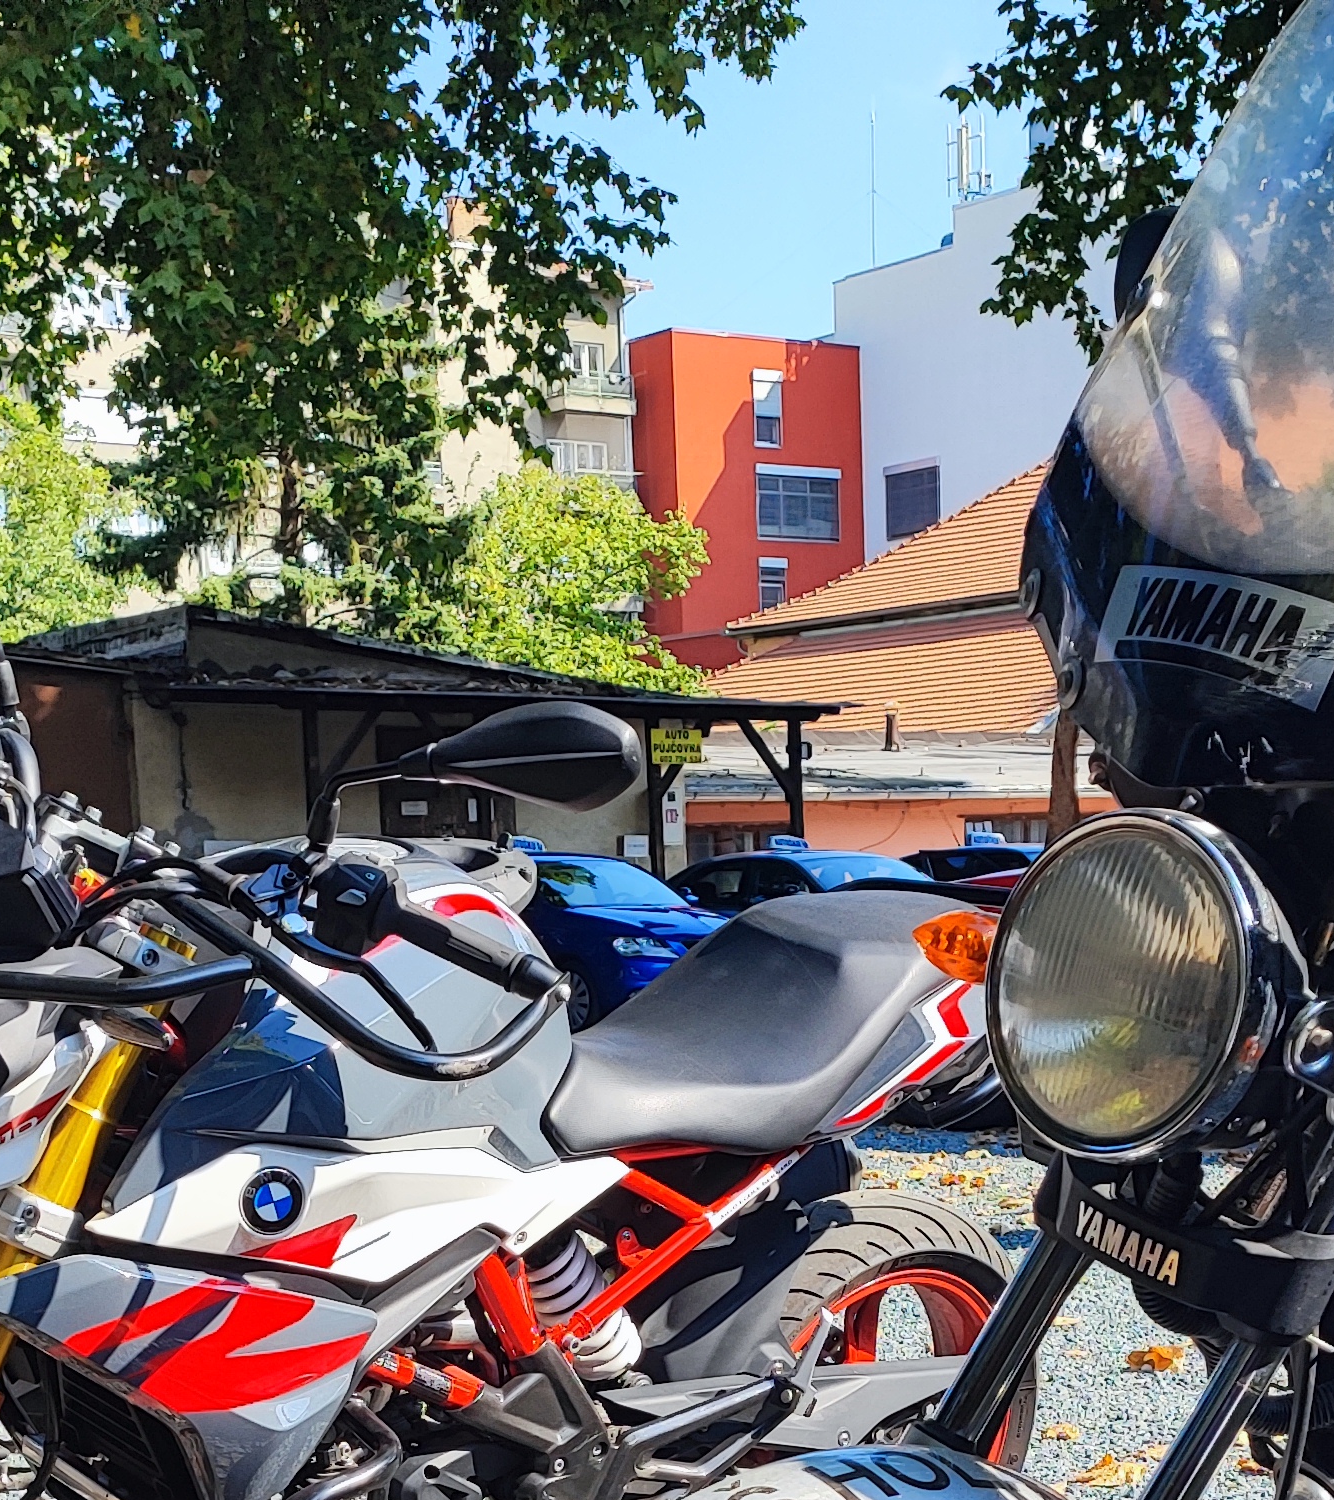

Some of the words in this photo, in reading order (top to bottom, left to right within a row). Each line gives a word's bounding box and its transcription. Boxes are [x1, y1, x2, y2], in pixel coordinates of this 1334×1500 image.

[1124, 576, 1307, 667] YAMAHA
[664, 729, 690, 740] AUTO
[245, 1170, 294, 1199] BMW
[1075, 1200, 1180, 1287] YAMAHA
